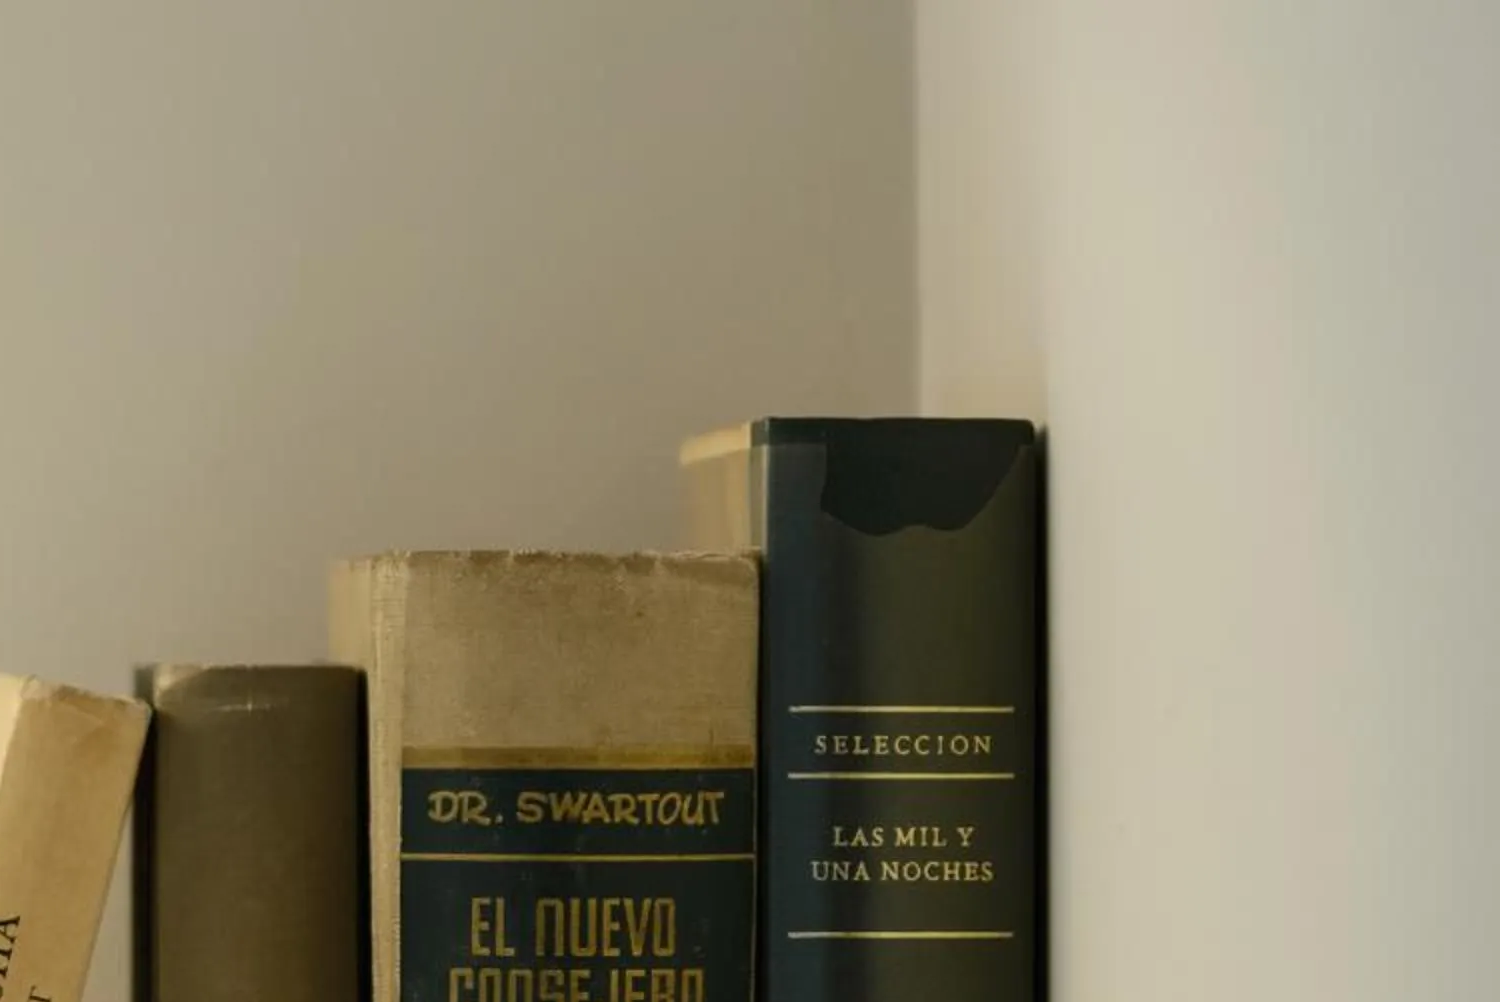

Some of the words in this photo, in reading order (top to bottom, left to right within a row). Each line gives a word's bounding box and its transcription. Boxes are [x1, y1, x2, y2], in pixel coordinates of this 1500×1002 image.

[813, 734, 992, 755] SELECCION
[428, 790, 504, 826] DR.
[516, 790, 726, 827] SWARTOUT
[833, 826, 885, 848] LAS
[894, 826, 947, 848] MIL
[956, 826, 976, 848] Y
[810, 860, 871, 882] UNA
[880, 860, 994, 882] NOCHES
[470, 896, 516, 957] EL
[535, 896, 677, 957] NUEVO
